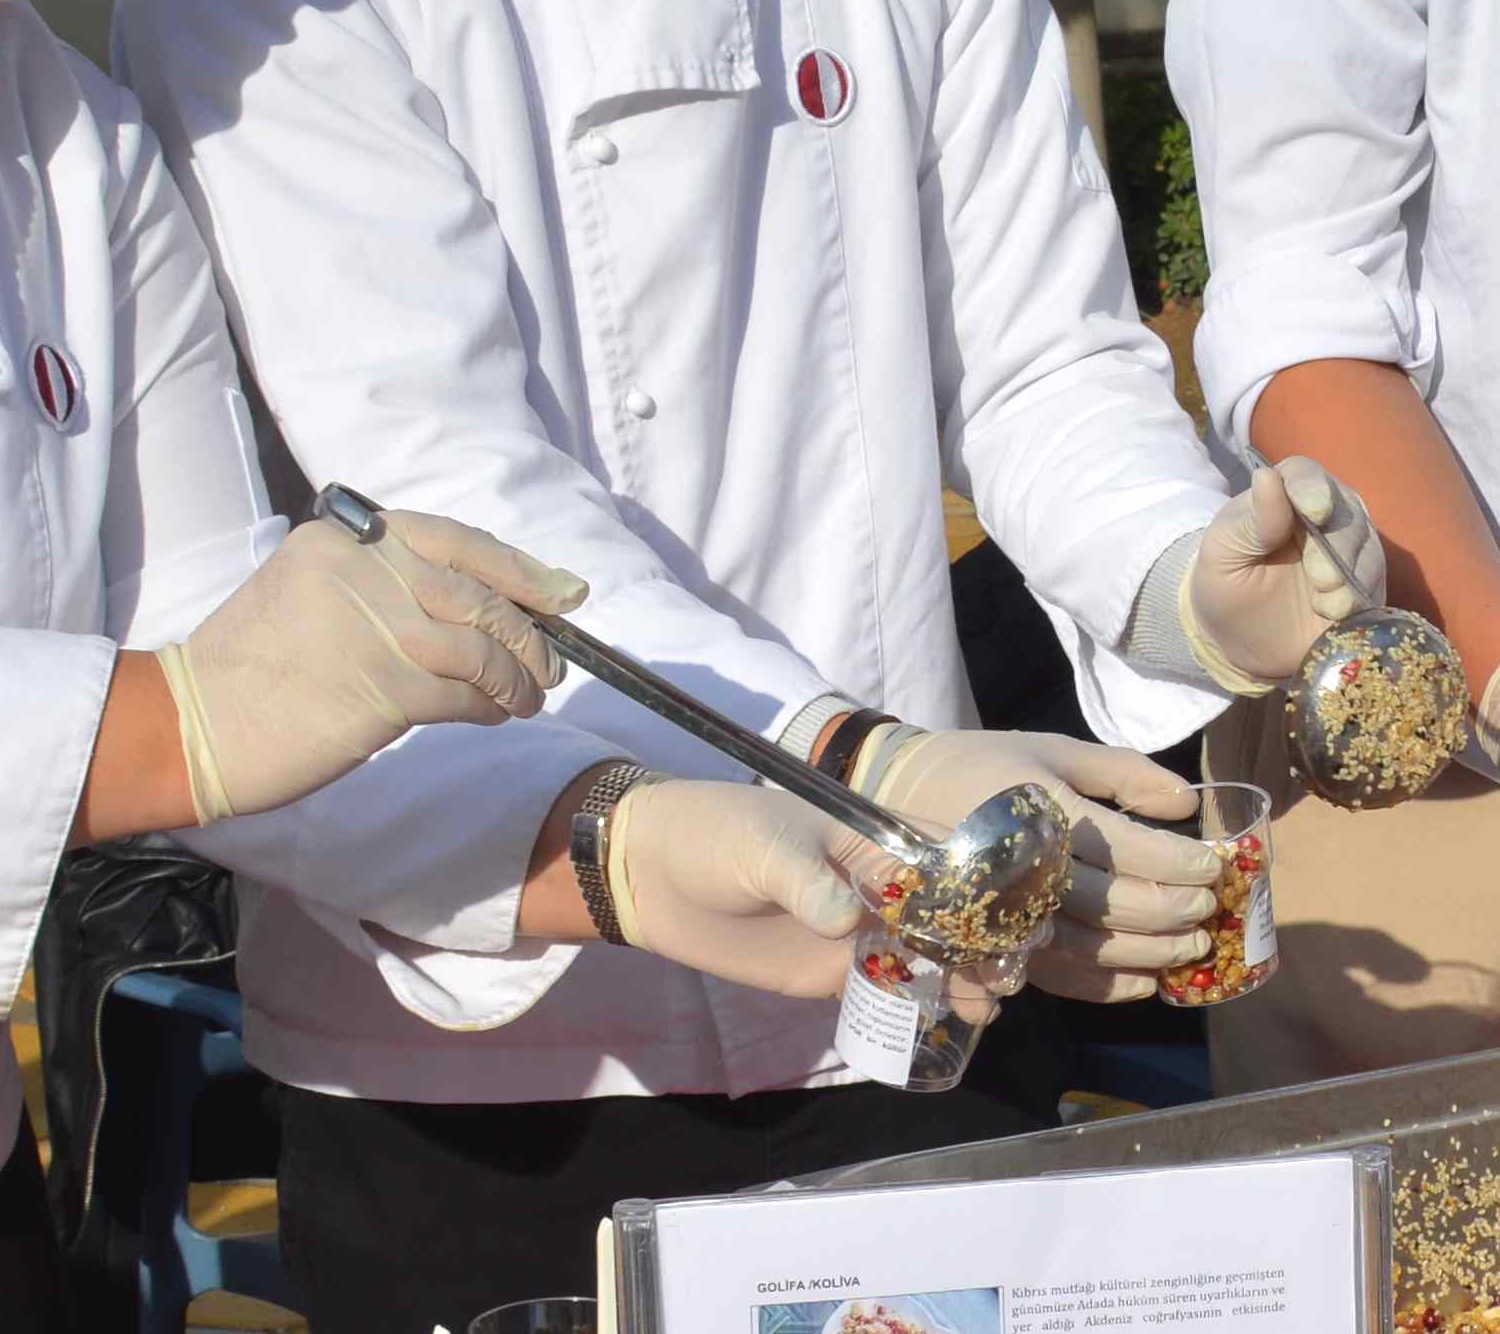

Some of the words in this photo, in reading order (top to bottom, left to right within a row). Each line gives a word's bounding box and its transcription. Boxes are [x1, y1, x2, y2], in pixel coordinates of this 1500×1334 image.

[757, 1278, 805, 1293] GOLİFA
[1011, 1286, 1046, 1297] Kıbrıs
[1050, 1281, 1095, 1297] mutfağı
[1098, 1277, 1146, 1290] kültürel
[1151, 1273, 1221, 1289] zenginliğine
[1225, 1268, 1284, 1284] geçmişten
[1011, 1301, 1073, 1317] günümüze
[1076, 1297, 1114, 1309] Adada
[1162, 1292, 1197, 1303] süren
[1011, 1324, 1032, 1334] yer
[1042, 1318, 1074, 1332] aldığı
[1083, 1313, 1132, 1326] Akdeniz
[1143, 1306, 1222, 1324] coğrafyasının
[1232, 1301, 1284, 1314] etkisinde
